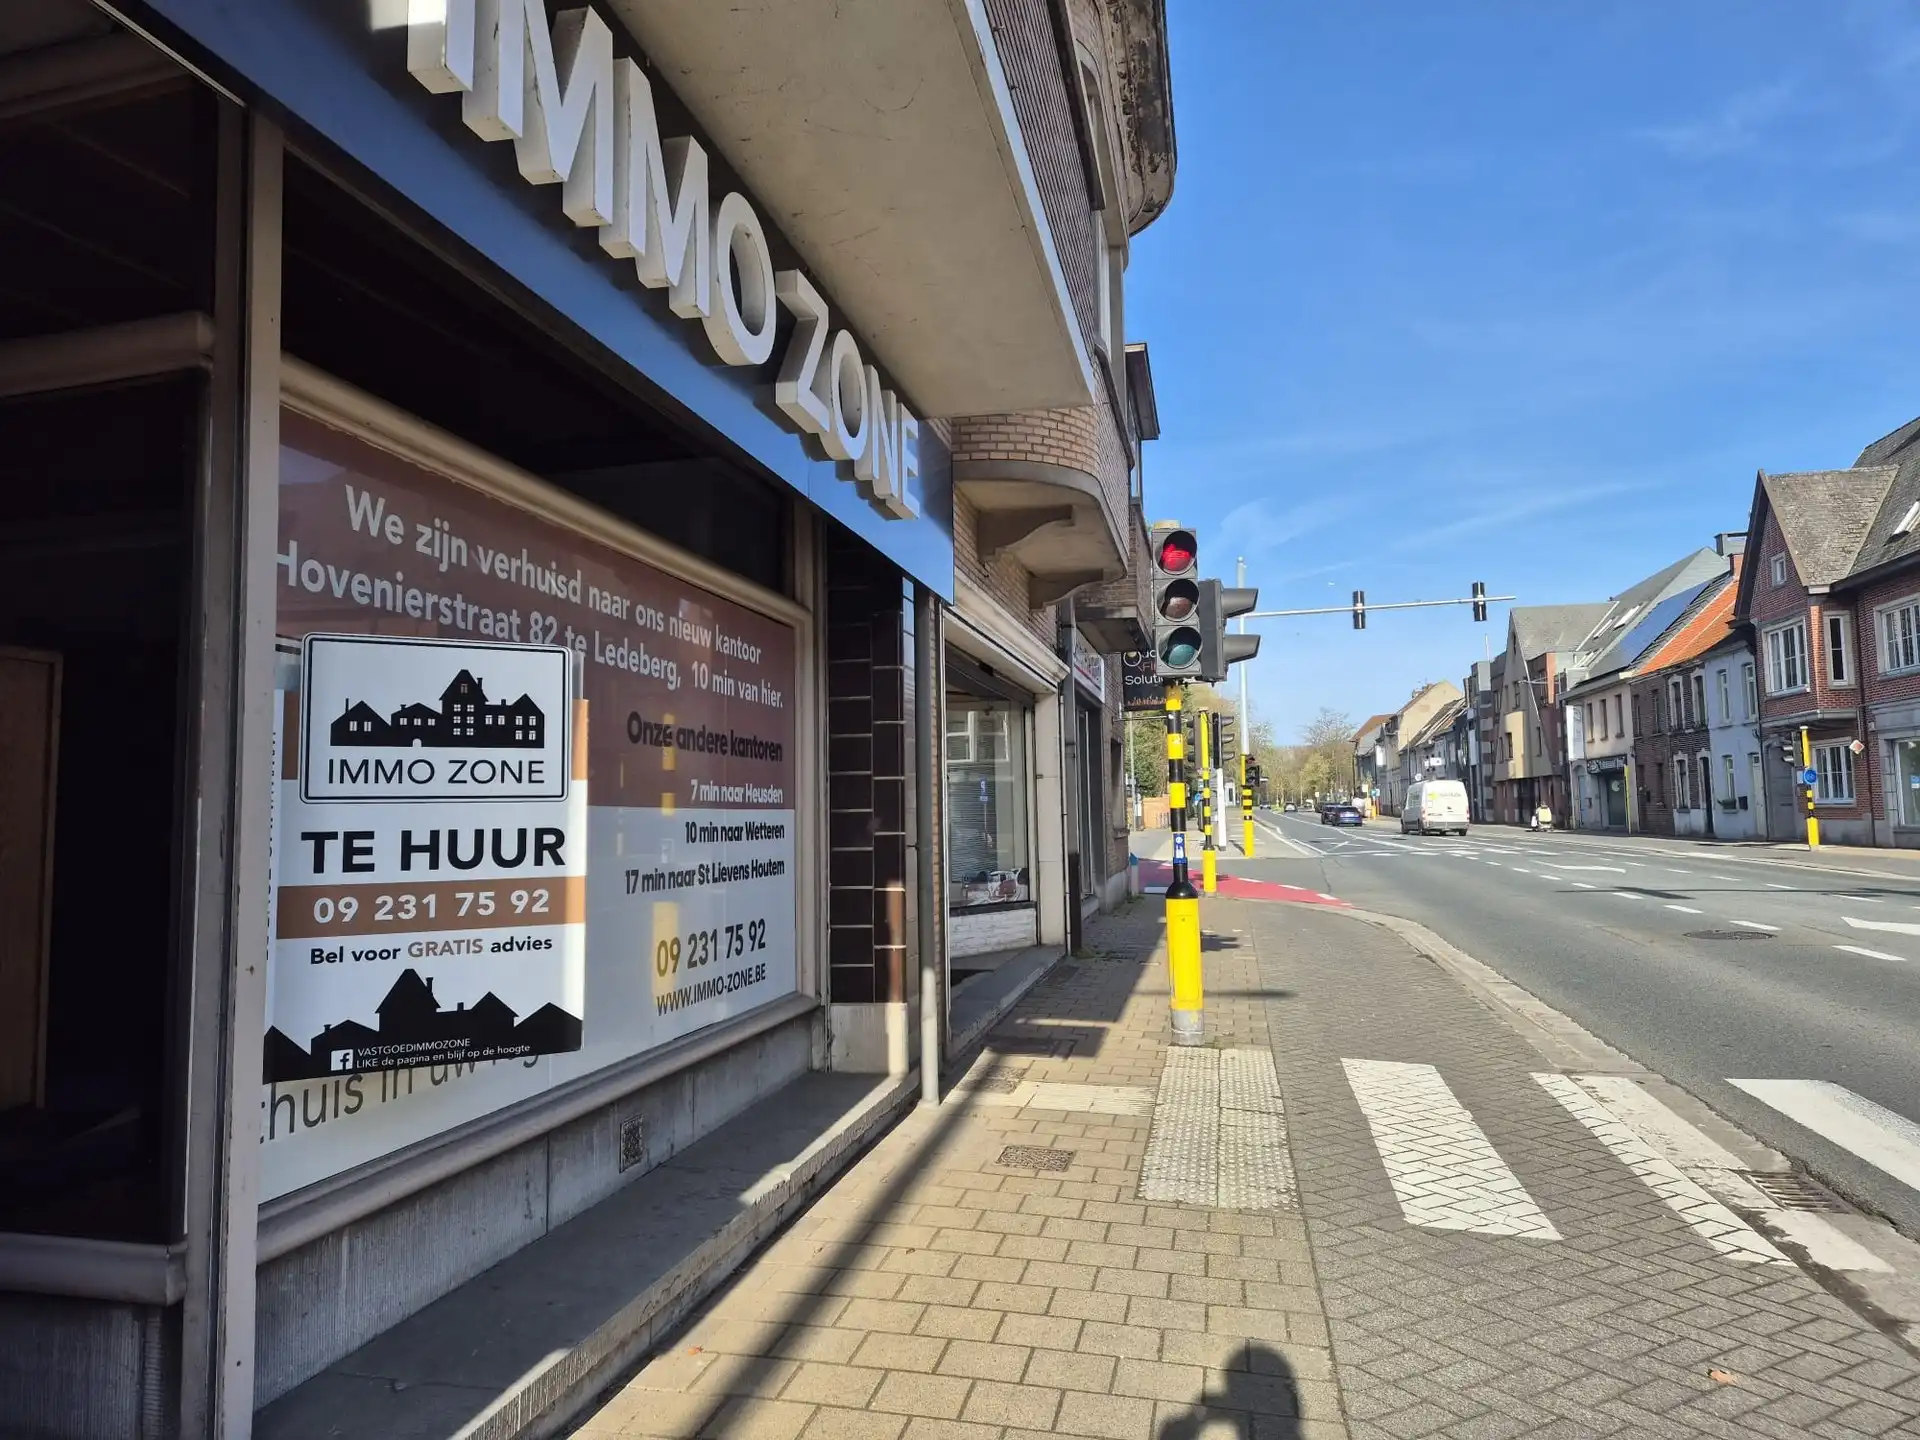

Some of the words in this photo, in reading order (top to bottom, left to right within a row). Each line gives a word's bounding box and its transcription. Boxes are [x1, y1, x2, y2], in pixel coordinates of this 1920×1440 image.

[775, 268, 919, 521] ZONE
[345, 484, 405, 545] We
[415, 517, 468, 573] zijn
[477, 545, 582, 604] verhuisd
[589, 584, 630, 620] naar
[636, 604, 665, 632] ons
[669, 609, 712, 648] nieuw
[715, 624, 762, 665] kantoor
[276, 539, 522, 642] Hovenierstraat
[530, 611, 558, 643] 82
[565, 625, 588, 657] te
[595, 630, 682, 690] Ledeberg,
[692, 660, 709, 690] 10
[712, 669, 735, 694] min
[738, 683, 758, 704] van
[761, 679, 784, 708] hier.
[627, 711, 673, 747] Onze
[676, 724, 728, 757] andere
[730, 730, 783, 763] kantoren
[328, 758, 436, 785] IMMO
[447, 759, 545, 785] ZONE
[690, 779, 698, 801] 7
[699, 781, 723, 802] min
[724, 785, 744, 803] naar
[745, 783, 783, 804] Heusden
[301, 830, 375, 874] TE
[400, 827, 566, 871] HUUR
[685, 821, 697, 844] 10
[699, 823, 719, 843] min
[720, 825, 743, 843] naar
[745, 822, 785, 842] Wetteren
[625, 869, 639, 894] 17
[641, 869, 666, 893] min
[668, 870, 696, 890] naar
[698, 864, 710, 886] St
[711, 860, 750, 884] Lievens
[751, 858, 785, 880] Houtem
[313, 896, 359, 923] 09
[374, 894, 436, 921] 231
[455, 891, 496, 917] 75
[510, 889, 549, 914] 92
[310, 946, 344, 965] Bel
[351, 947, 401, 962] voor
[407, 938, 484, 958] GRATIS
[490, 935, 553, 954] advies
[656, 937, 681, 977] 09
[687, 928, 718, 969] 231
[725, 922, 744, 959] 75
[748, 918, 766, 951] 92
[656, 963, 766, 1017] WWW.IMMO-ZONE.BE
[356, 1059, 379, 1069] LIKE
[381, 1057, 395, 1067] de
[397, 1053, 430, 1069] pagina
[432, 1053, 445, 1061] en
[447, 1049, 465, 1061] blijf
[467, 1049, 480, 1060] op
[482, 1046, 495, 1056] de
[497, 1043, 531, 1056] hoogte
[357, 1037, 471, 1056] VASTGOEDIMMOZONE
